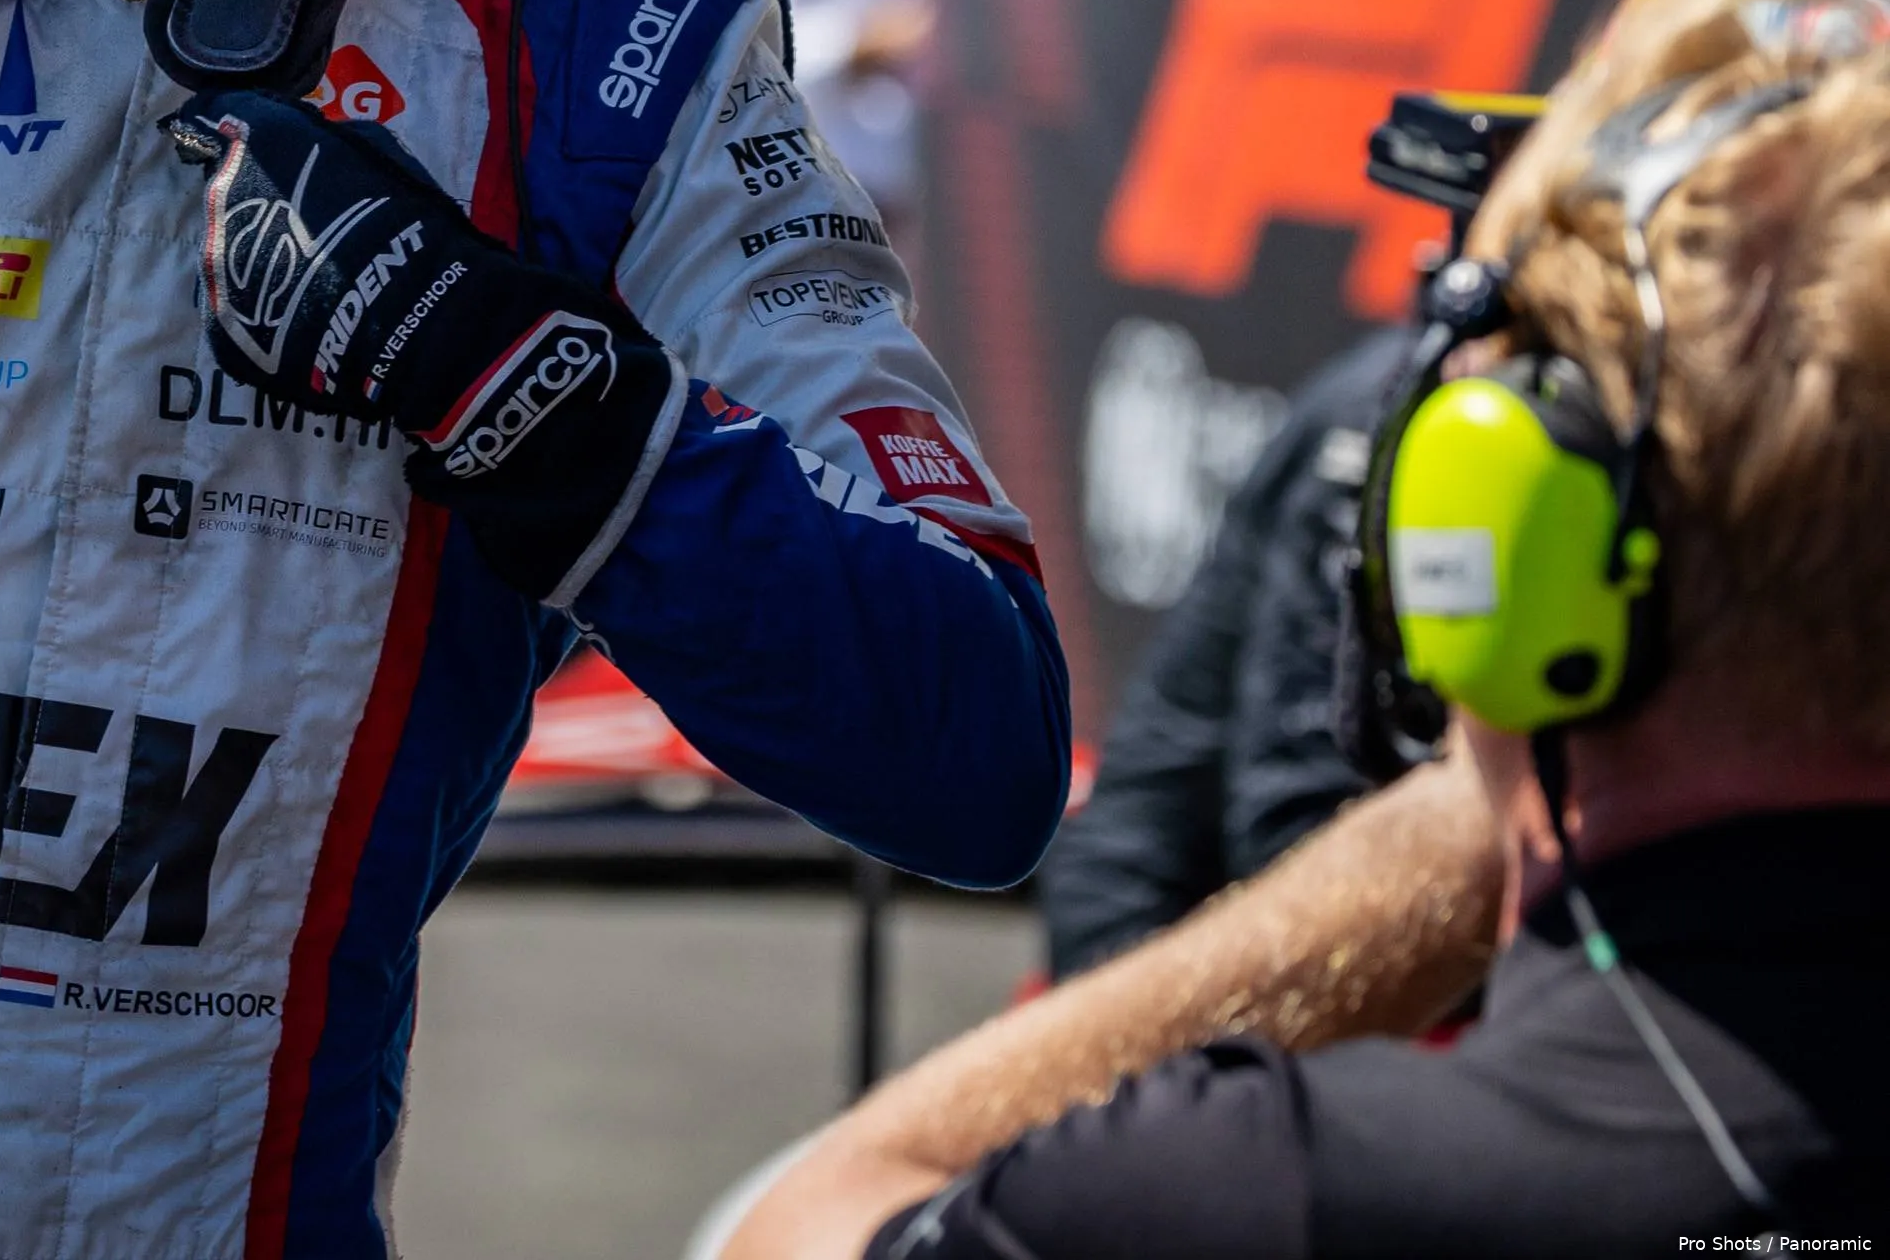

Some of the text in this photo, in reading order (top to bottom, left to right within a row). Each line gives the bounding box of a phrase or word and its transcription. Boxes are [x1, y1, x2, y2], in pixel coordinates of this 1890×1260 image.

[311, 220, 425, 395] TRIDENT
[822, 310, 864, 326] GROUP
[445, 335, 601, 479] sparco
[878, 434, 949, 458] KOFFIE
[891, 455, 969, 486] MAX
[198, 518, 246, 533] BEYOND
[249, 522, 287, 538] SMART
[201, 491, 390, 540] SMARTICATE
[63, 982, 277, 1018] R.VERSCHOOR
